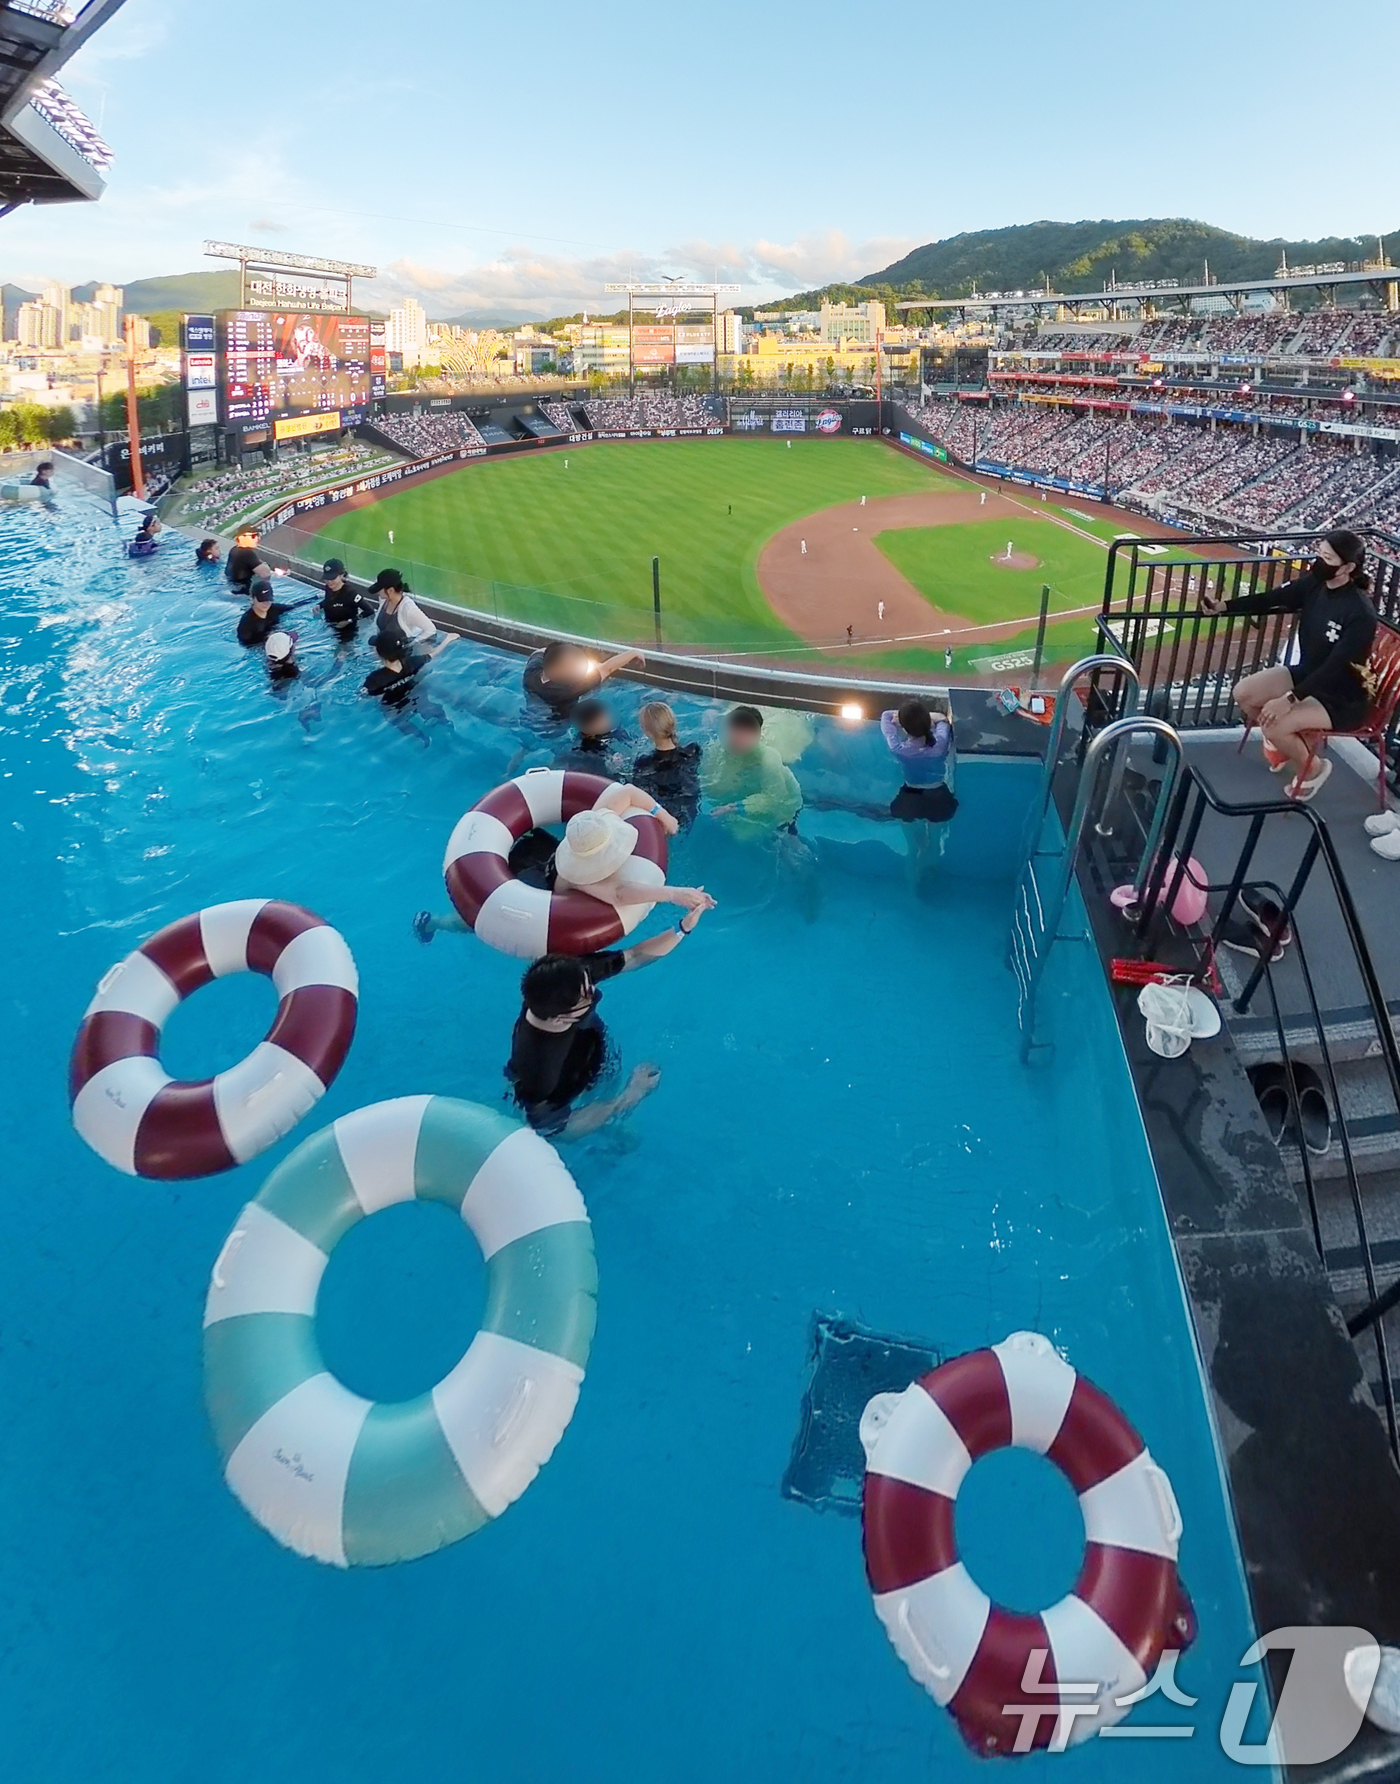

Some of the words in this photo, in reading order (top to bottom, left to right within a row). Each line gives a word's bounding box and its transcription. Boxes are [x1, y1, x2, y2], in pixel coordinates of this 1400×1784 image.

[250, 280, 273, 296] 대전
[276, 282, 317, 299] 한화생명
[319, 287, 347, 301] 볼파크
[250, 298, 277, 308] Daejeon
[278, 300, 307, 310] Hanwha
[307, 302, 321, 310] Life
[656, 301, 692, 318] Eagles
[191, 375, 211, 385] intel
[1297, 420, 1317, 429] GS25
[991, 656, 1034, 671] GS25
